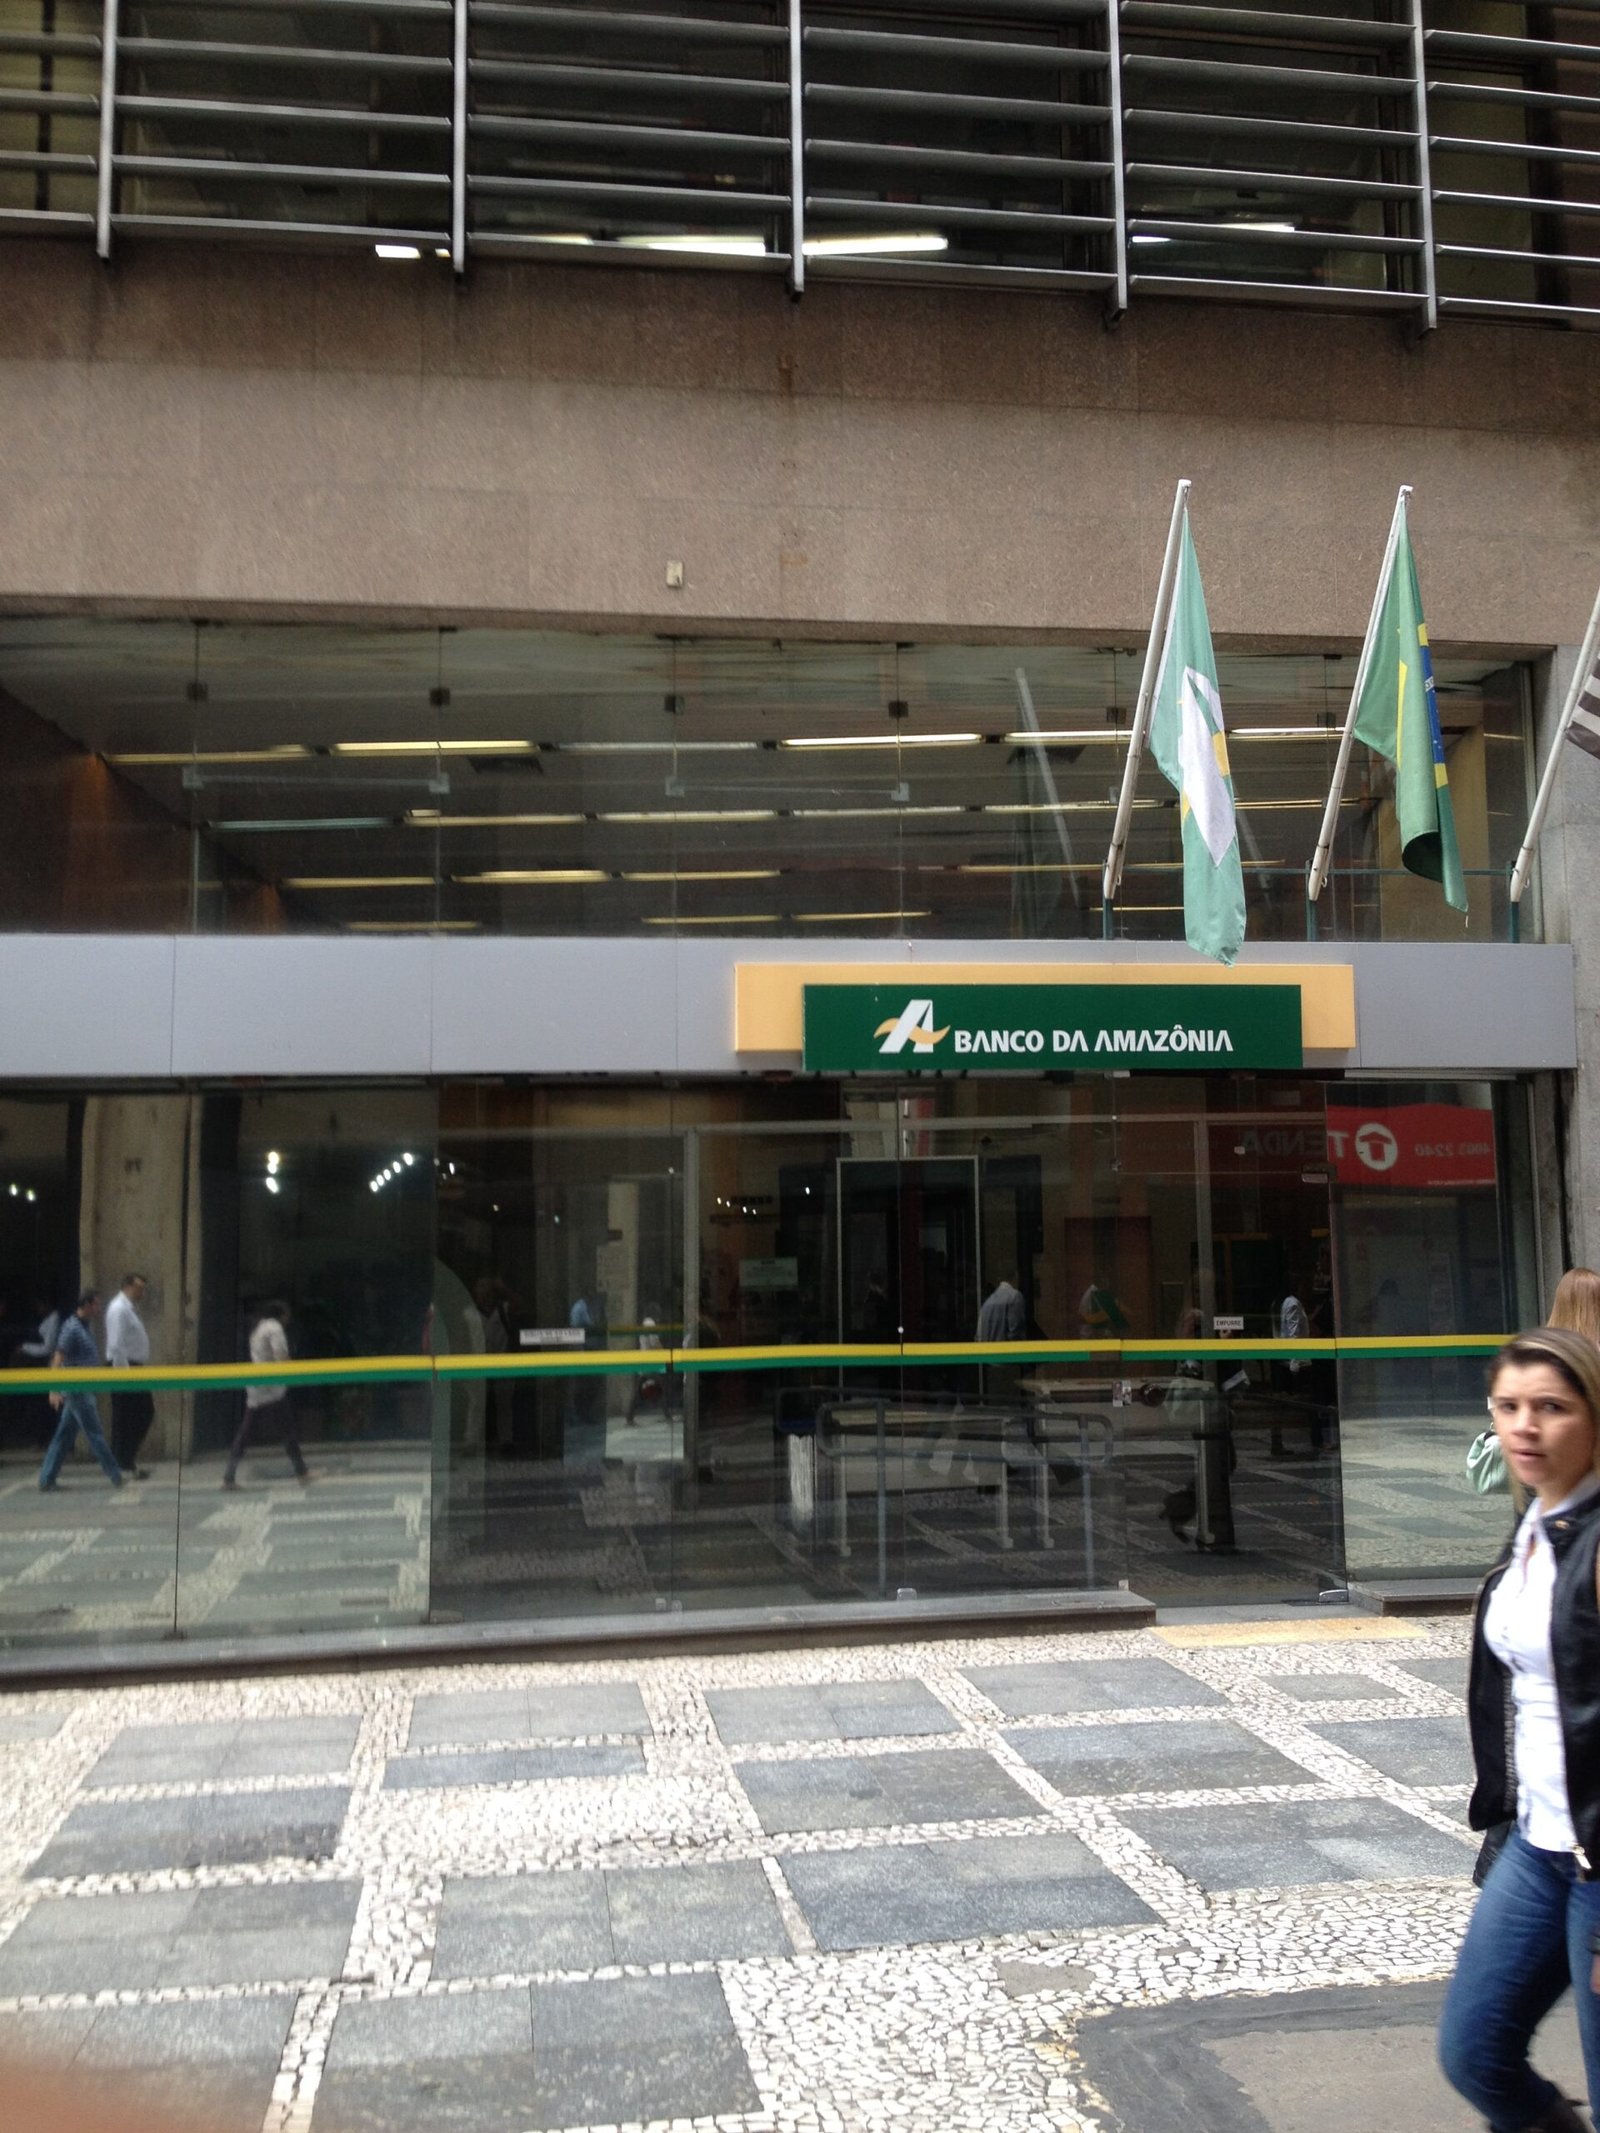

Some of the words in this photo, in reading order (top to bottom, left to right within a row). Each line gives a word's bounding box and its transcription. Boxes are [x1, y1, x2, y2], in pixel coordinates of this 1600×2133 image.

[955, 1031, 1044, 1052] BANCO
[1053, 1031, 1088, 1051] DA
[1095, 1025, 1233, 1051] AMAZÔNIA
